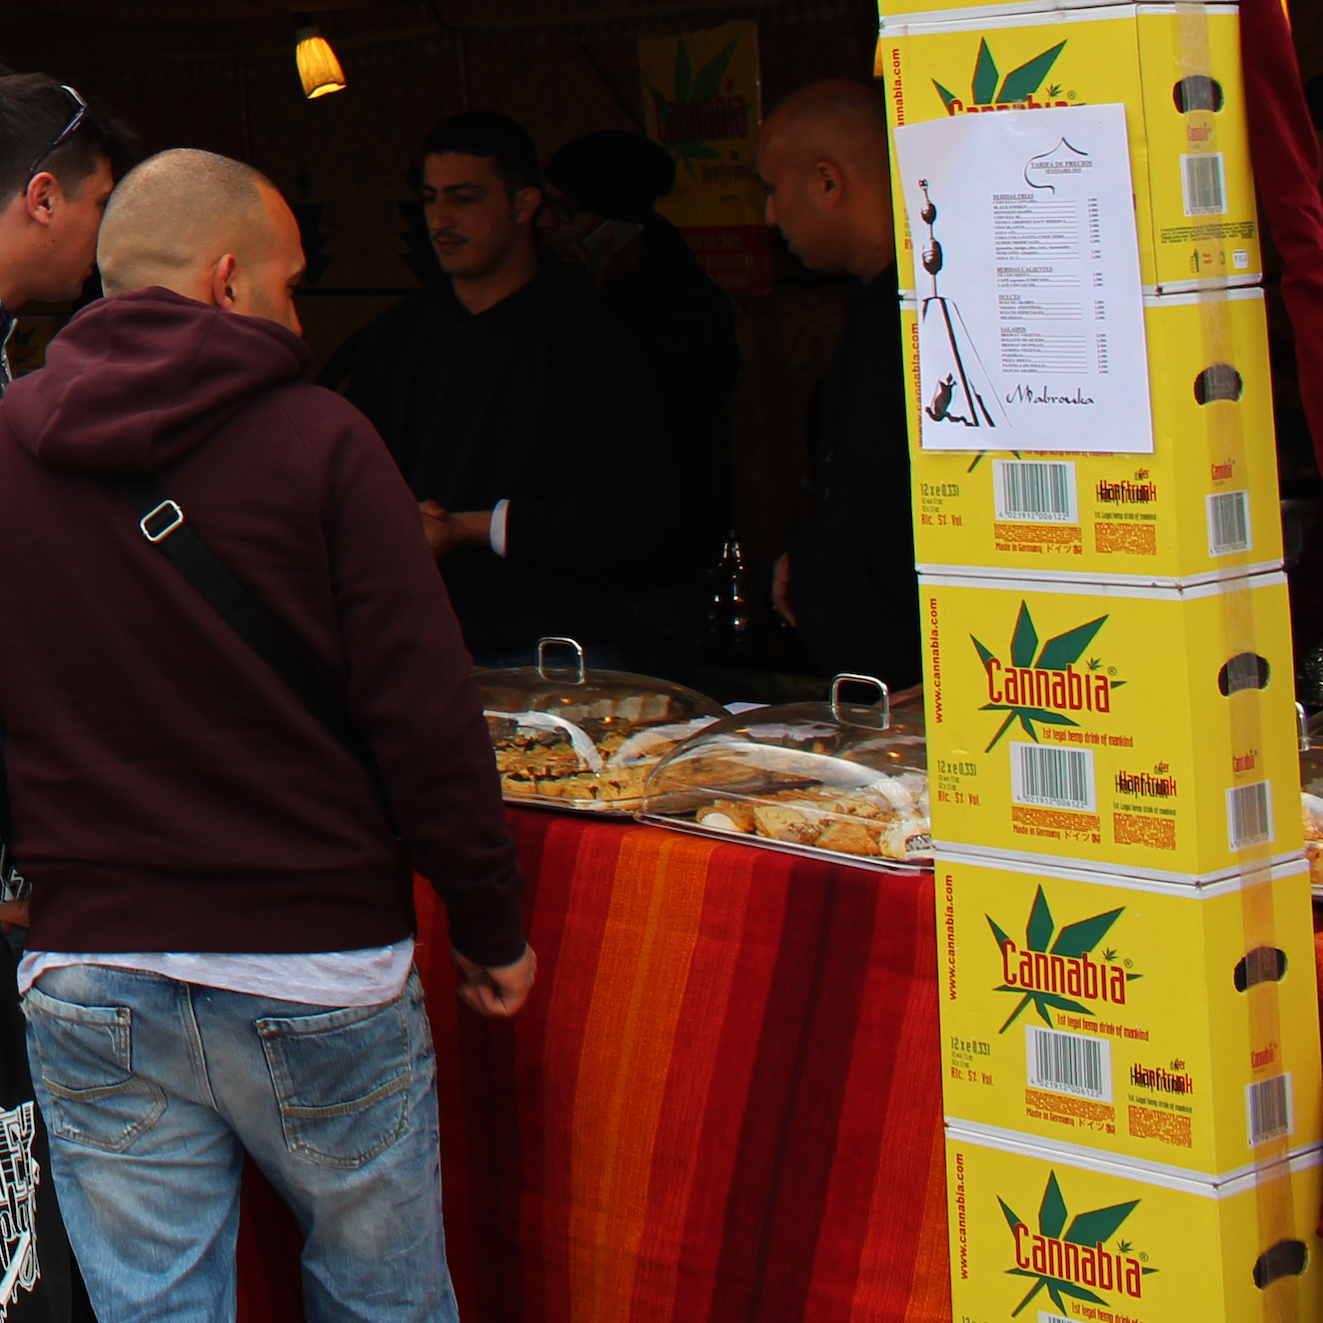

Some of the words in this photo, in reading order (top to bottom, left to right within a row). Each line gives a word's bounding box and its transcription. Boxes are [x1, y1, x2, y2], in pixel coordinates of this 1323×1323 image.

[1006, 383, 1095, 405] Mabrouka
[930, 598, 943, 724] www.cannabia.com
[988, 657, 1111, 713] Cannabia
[1043, 728, 1051, 739] 1st
[1053, 729, 1067, 742] legal
[1068, 730, 1083, 744] hemp
[1085, 732, 1099, 744] drink
[1101, 734, 1108, 746] of
[1109, 734, 1133, 748] mankind
[937, 760, 946, 773] 12
[1013, 825, 1027, 835] Made
[1035, 827, 1060, 840] Germany
[943, 874, 957, 1001] www.cannabia.com
[1003, 939, 1126, 1004] Cannabia
[1057, 1014, 1066, 1026] 1st
[1067, 1015, 1081, 1030] legal
[1083, 1017, 1098, 1032] hemp
[1100, 1020, 1115, 1035] drink
[1116, 1023, 1123, 1038] of
[1124, 1025, 1149, 1042] mankind
[950, 1036, 959, 1050] 12
[1026, 1107, 1042, 1119] Made
[1049, 1112, 1075, 1127] Germany
[955, 1152, 969, 1280] www.cannabia.com
[1014, 1223, 1142, 1299] Cannabia
[1071, 1301, 1080, 1314] 1st
[1082, 1303, 1096, 1319] legal
[1098, 1308, 1113, 1323] hemp
